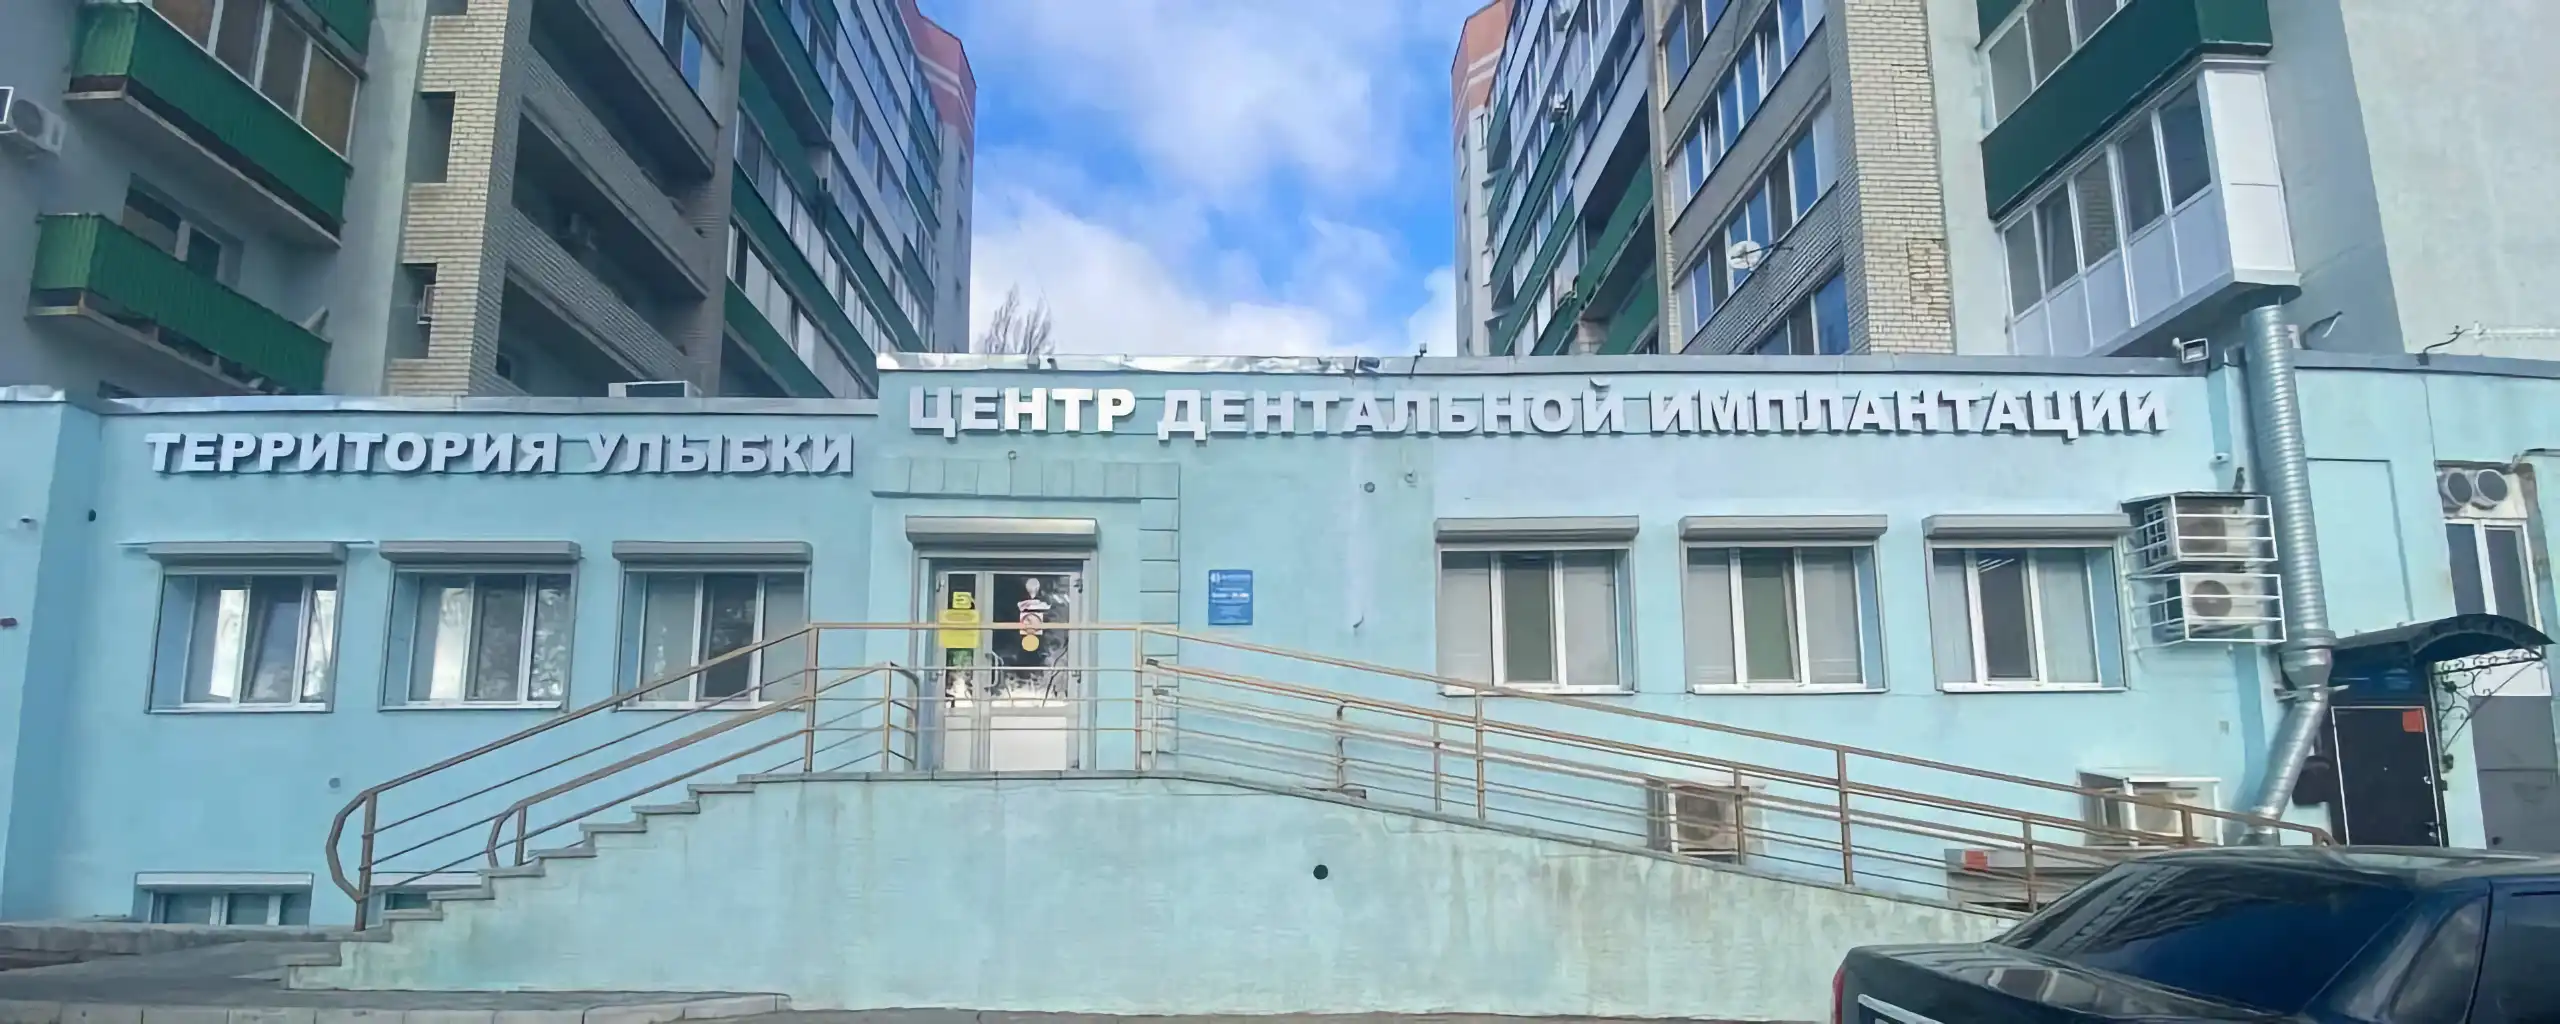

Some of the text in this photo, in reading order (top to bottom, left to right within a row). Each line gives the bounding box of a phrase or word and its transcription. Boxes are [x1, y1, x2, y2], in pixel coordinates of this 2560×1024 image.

[909, 376, 2168, 442] ЦЕНТР ДЕНТАЛЬНОЙ ИМПЛАНТАЦИИ
[145, 432, 854, 474] ТЕРРИТОРИЯ УЛЫБКИ
